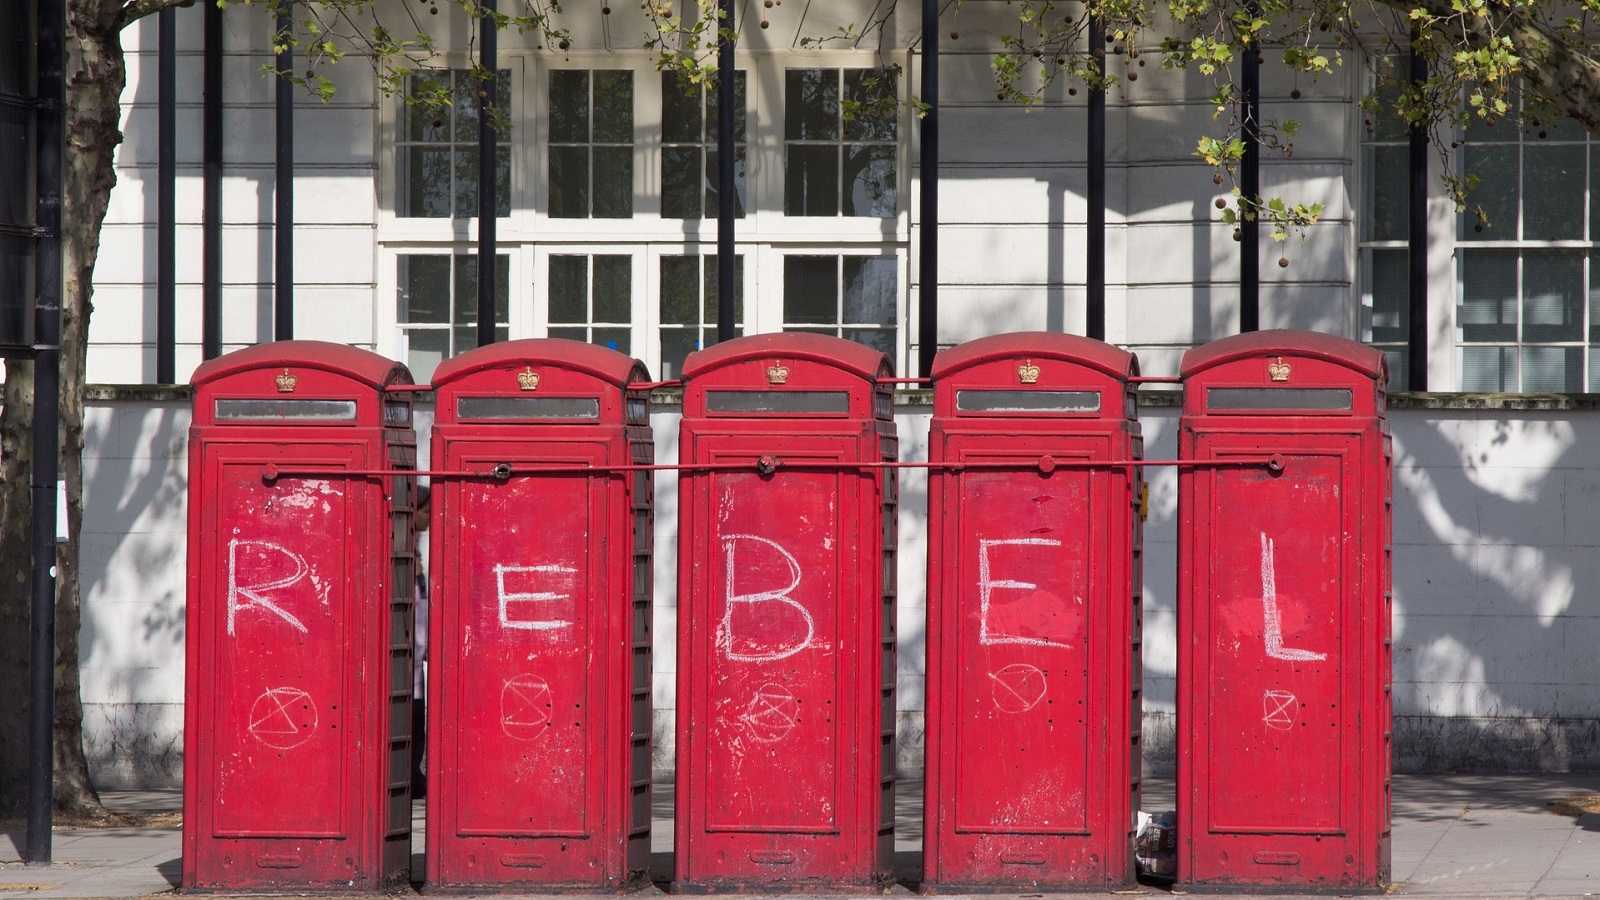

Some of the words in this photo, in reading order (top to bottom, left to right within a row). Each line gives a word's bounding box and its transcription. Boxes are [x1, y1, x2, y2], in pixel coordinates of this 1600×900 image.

[228, 539, 309, 637] R
[493, 563, 578, 630] E
[721, 534, 815, 663] B
[977, 538, 1074, 650] E
[1260, 531, 1328, 662] L
